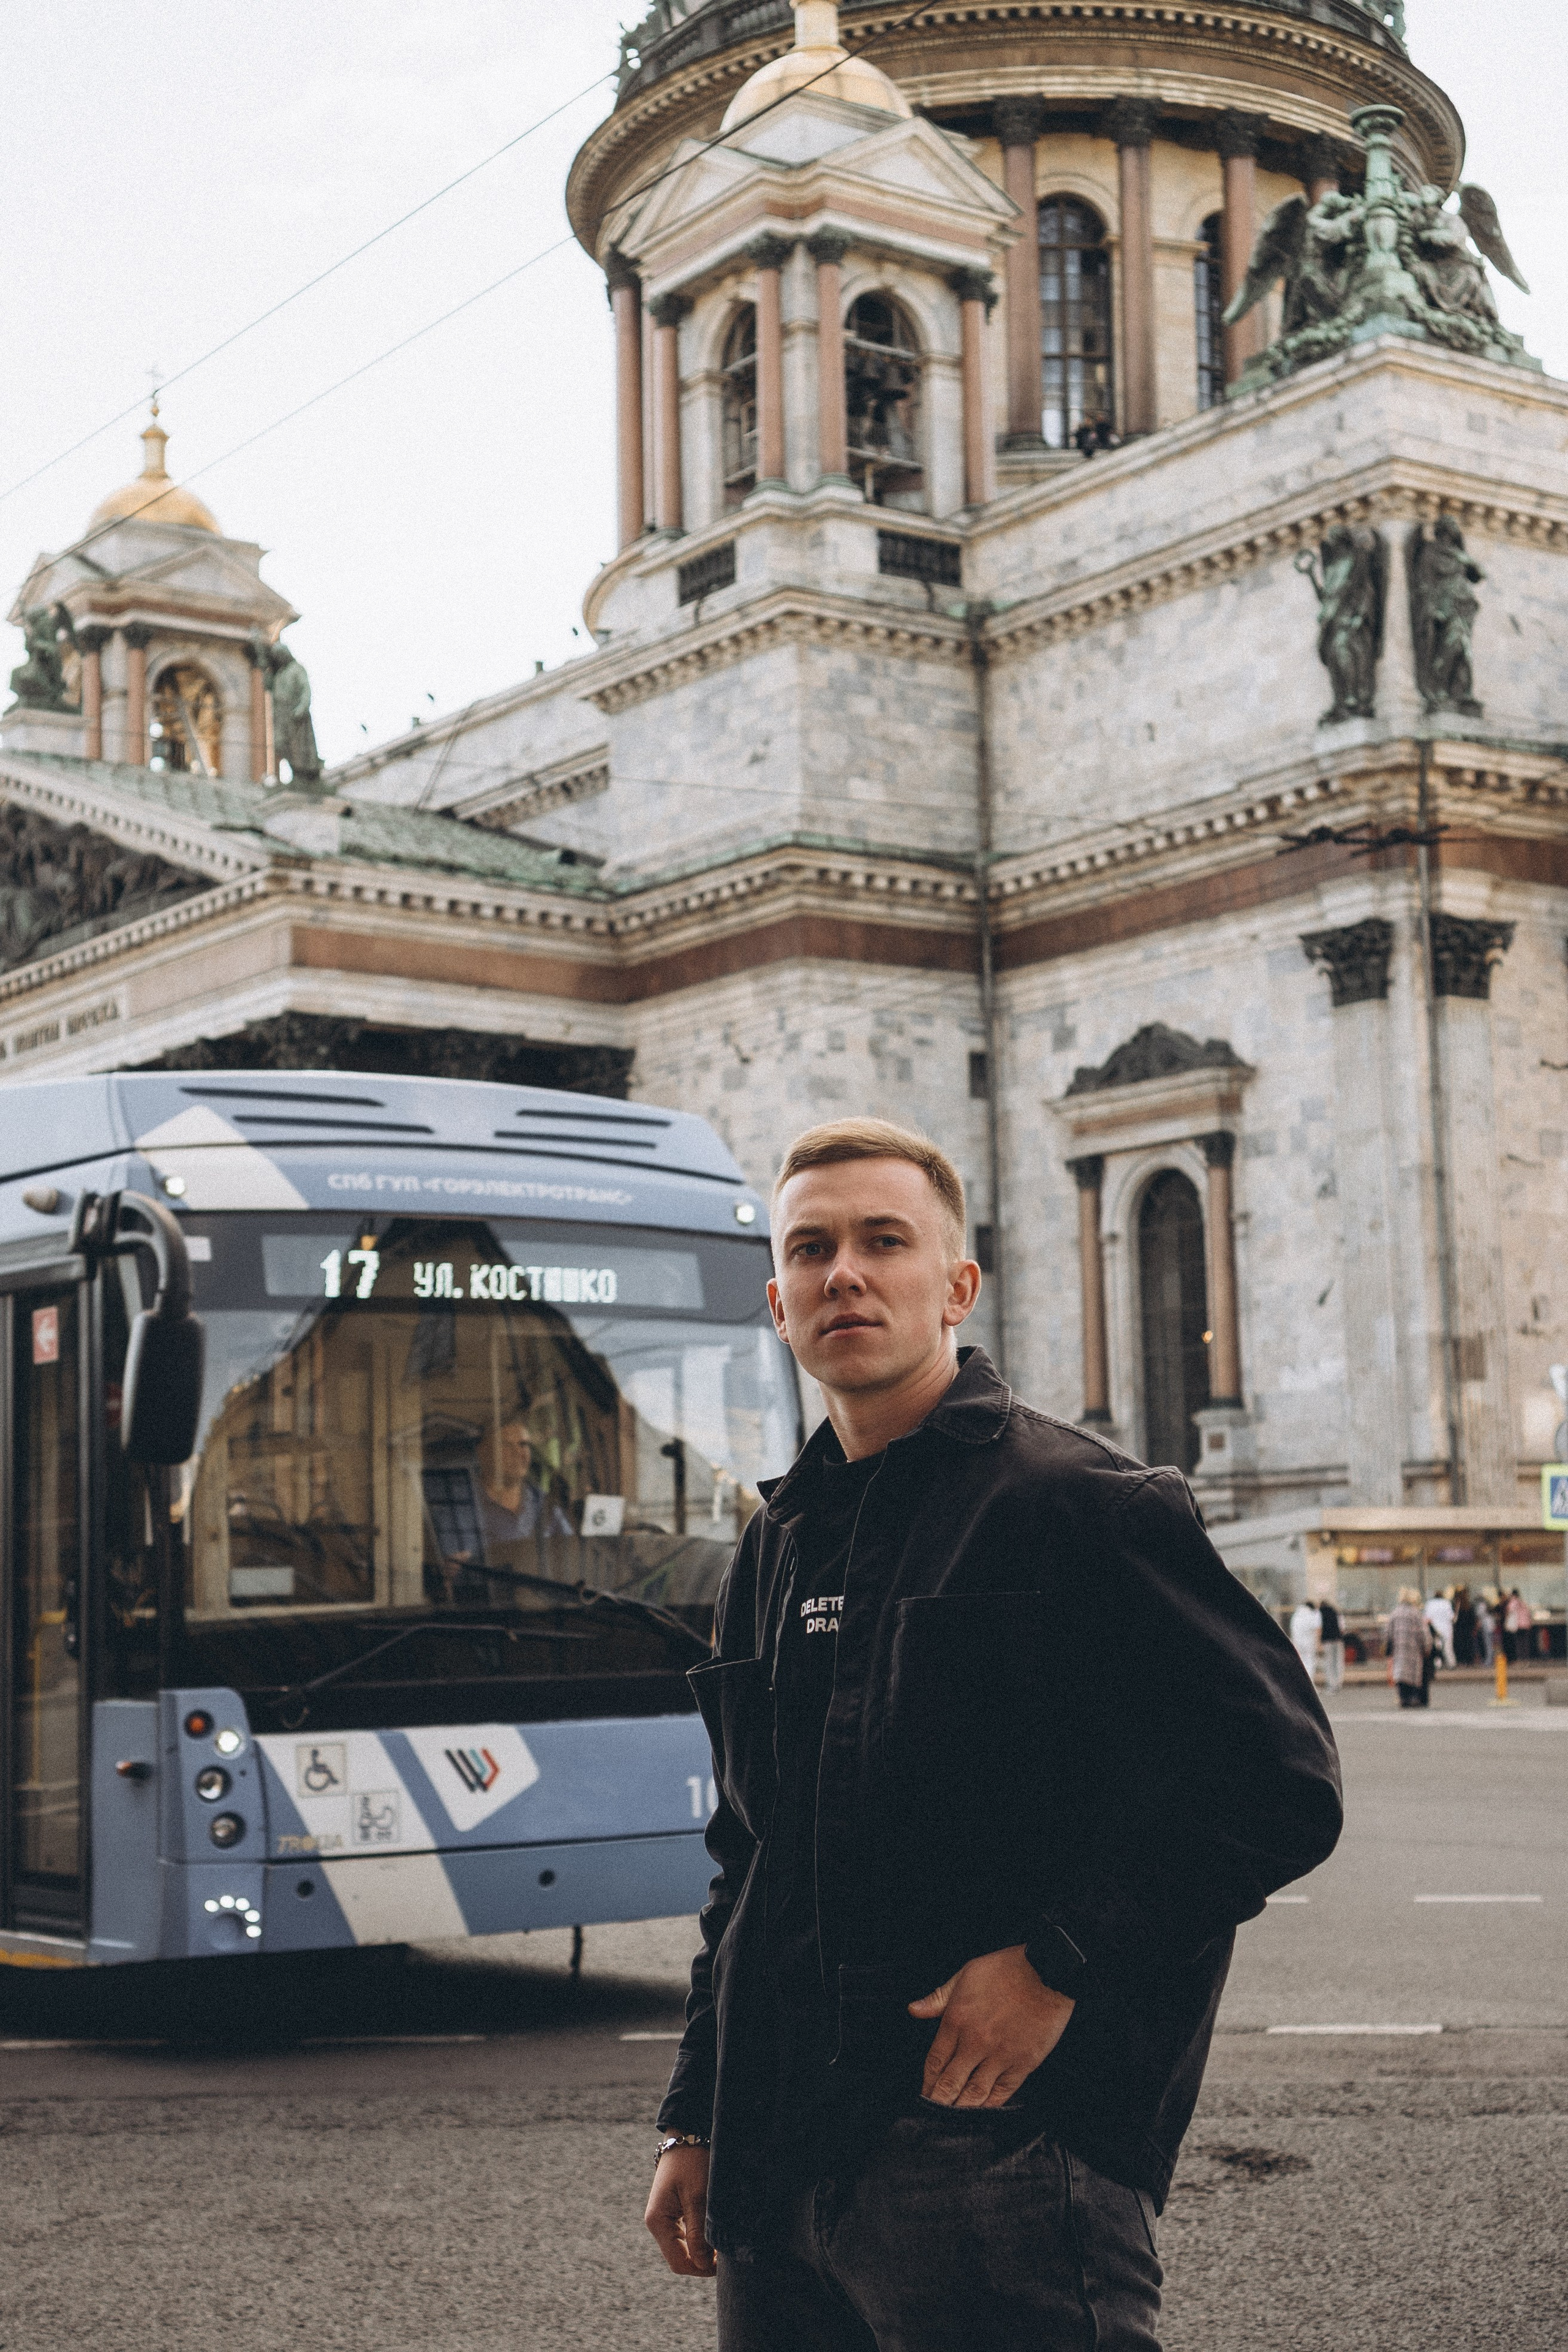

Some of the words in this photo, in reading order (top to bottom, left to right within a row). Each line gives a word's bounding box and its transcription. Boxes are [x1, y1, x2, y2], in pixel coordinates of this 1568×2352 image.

[319, 1249, 380, 1299] 17
[413, 1262, 464, 1300] УЛ.
[469, 1264, 618, 1304] КОСТКО
[801, 1595, 845, 1618] DELETE
[806, 1617, 839, 1634] DRA
